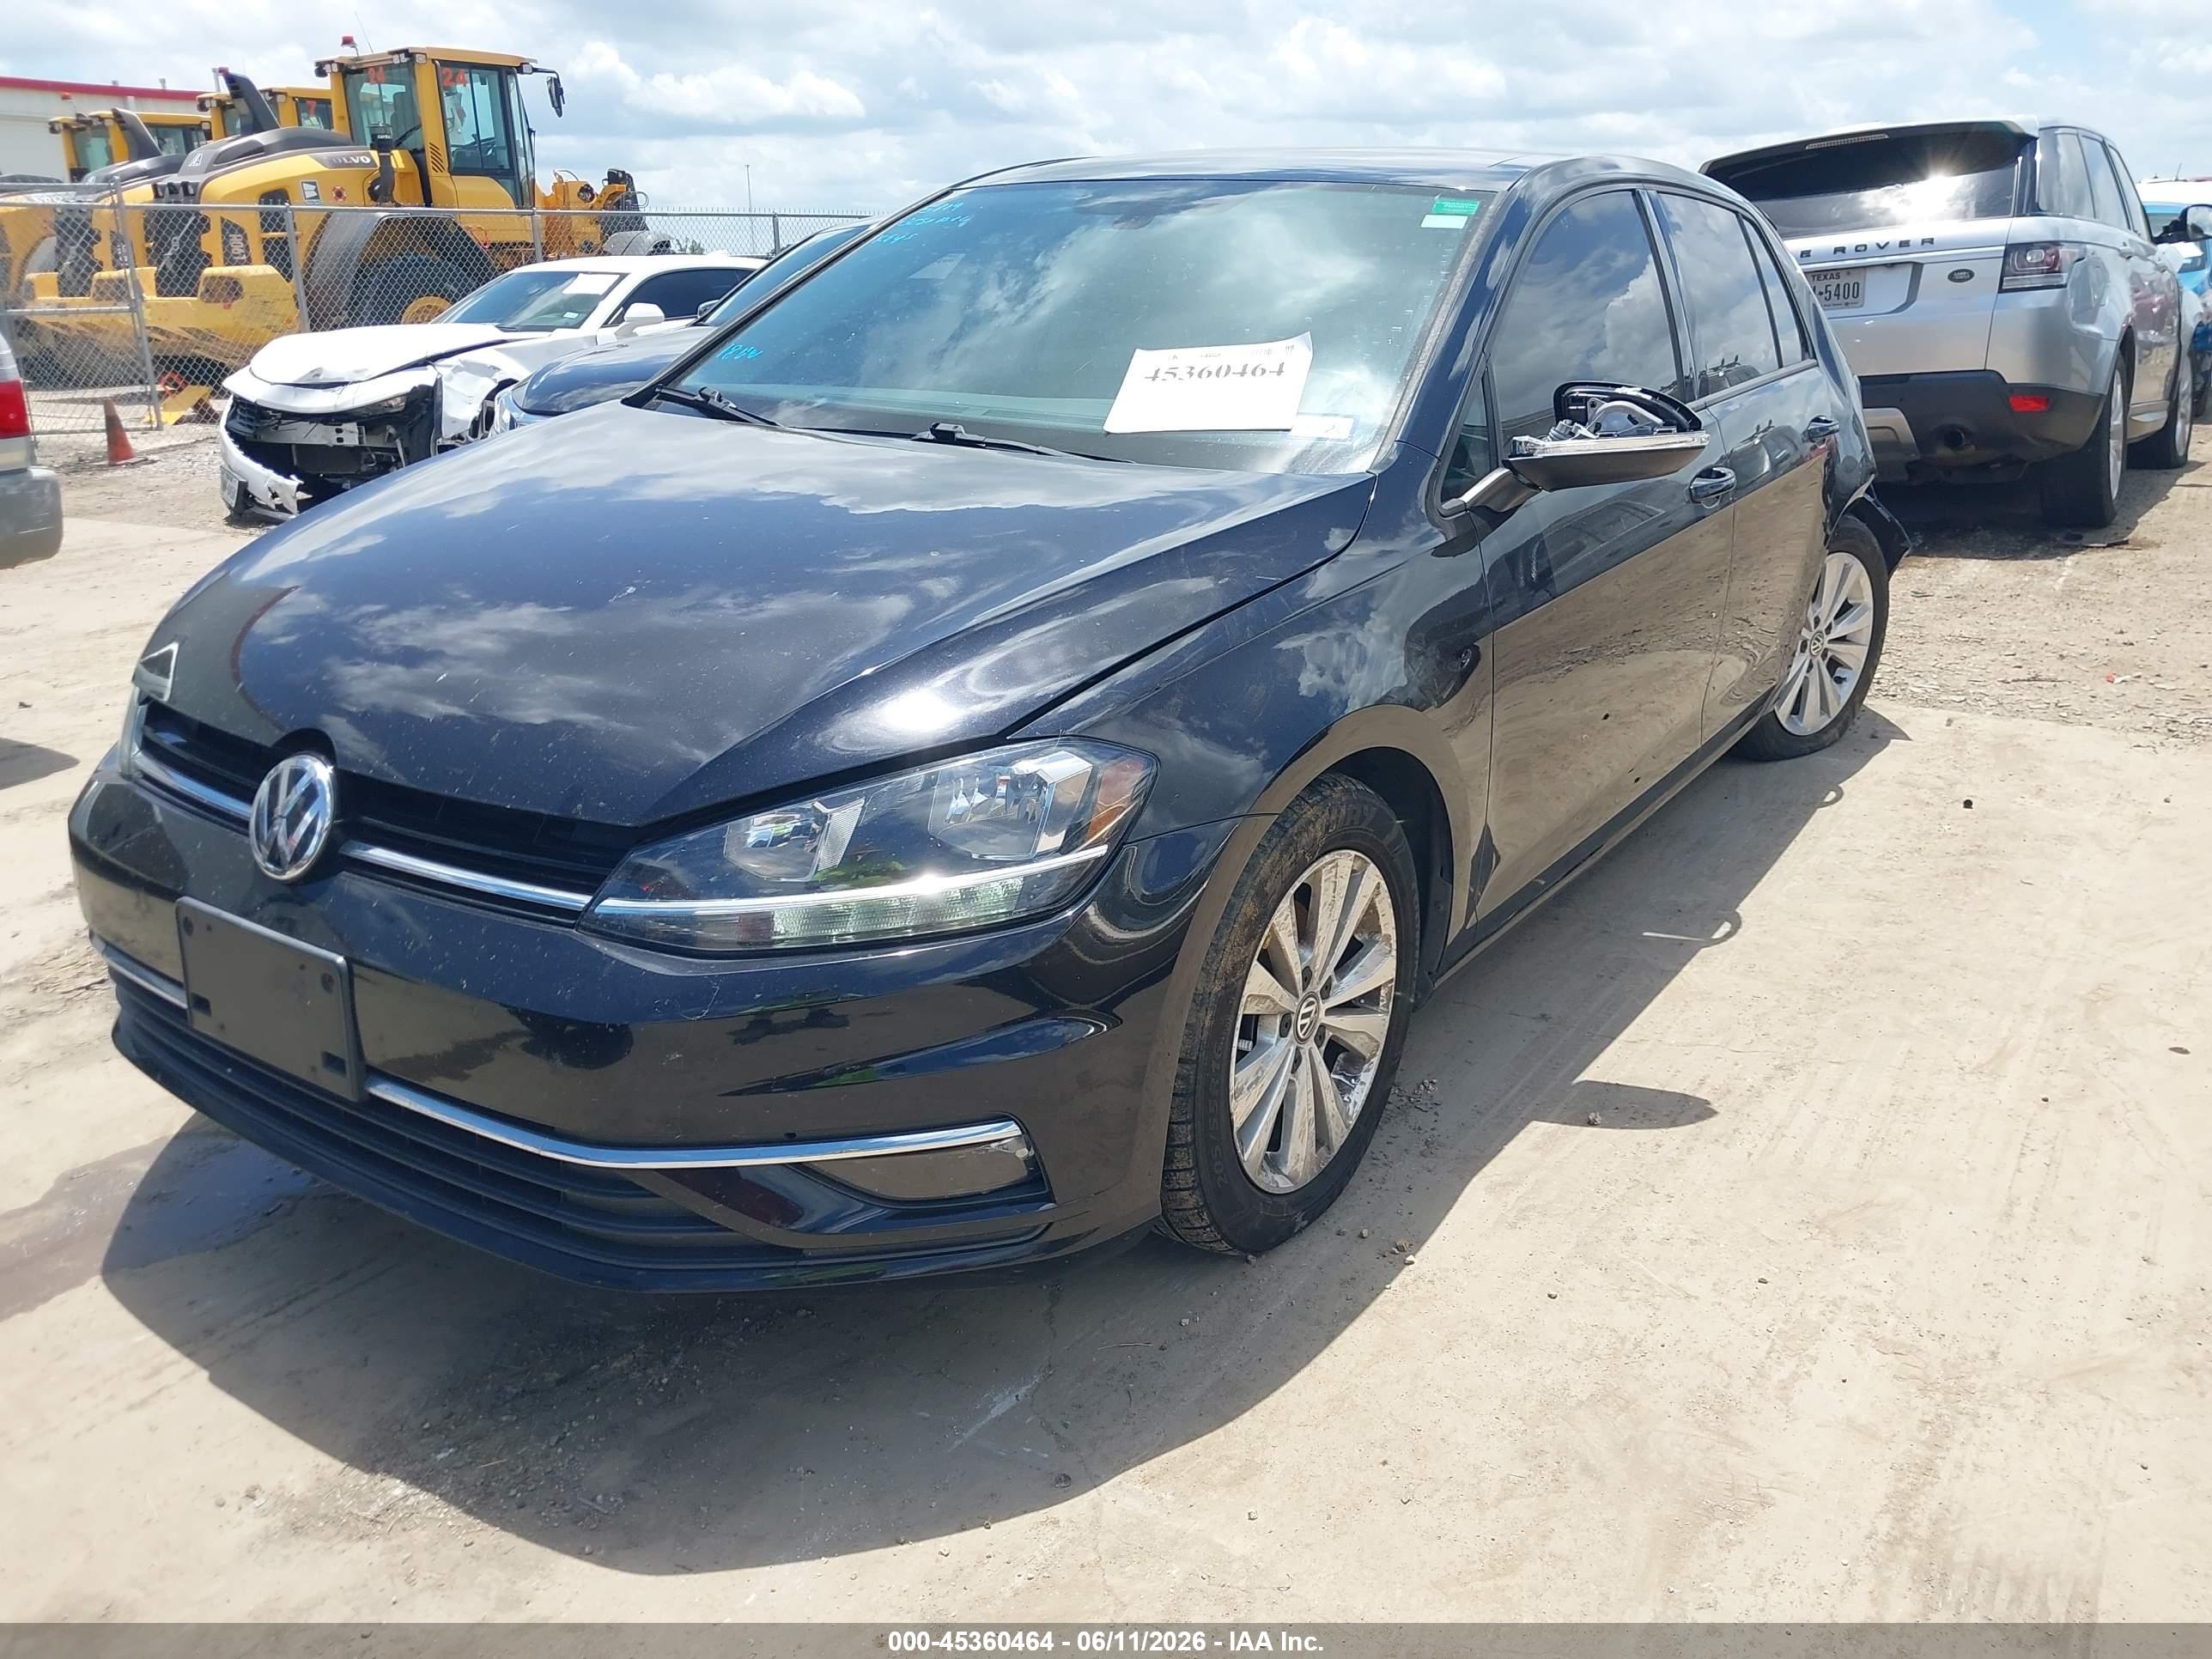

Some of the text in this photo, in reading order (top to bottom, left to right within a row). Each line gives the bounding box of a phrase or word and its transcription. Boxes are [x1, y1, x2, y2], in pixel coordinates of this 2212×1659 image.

[441, 67, 467, 87] 24
[326, 155, 371, 164] OLVO
[1833, 237, 1935, 255] ROVER
[1811, 271, 1841, 282] TEXAS
